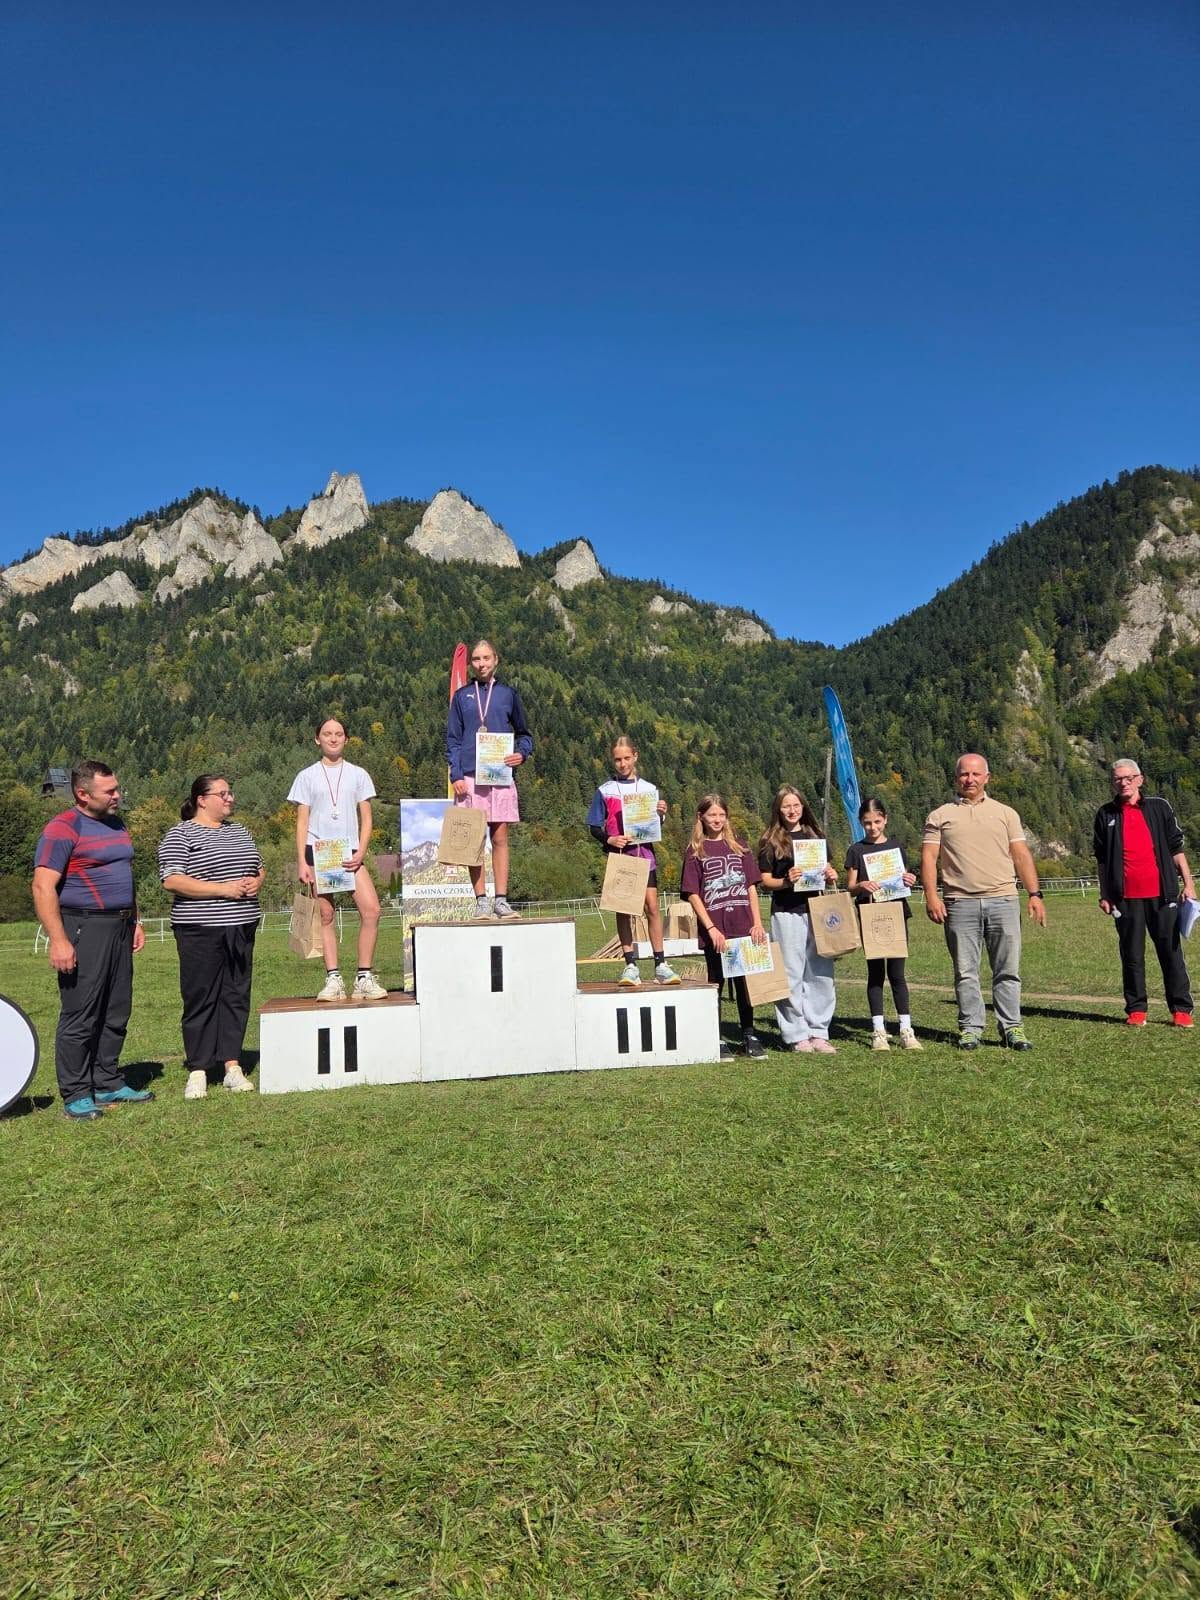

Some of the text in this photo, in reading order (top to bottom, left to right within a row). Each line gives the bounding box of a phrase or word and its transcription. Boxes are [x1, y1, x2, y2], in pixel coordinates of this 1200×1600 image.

[702, 854, 743, 880] 92
[317, 1025, 358, 1075] II
[616, 1006, 678, 1054] III
